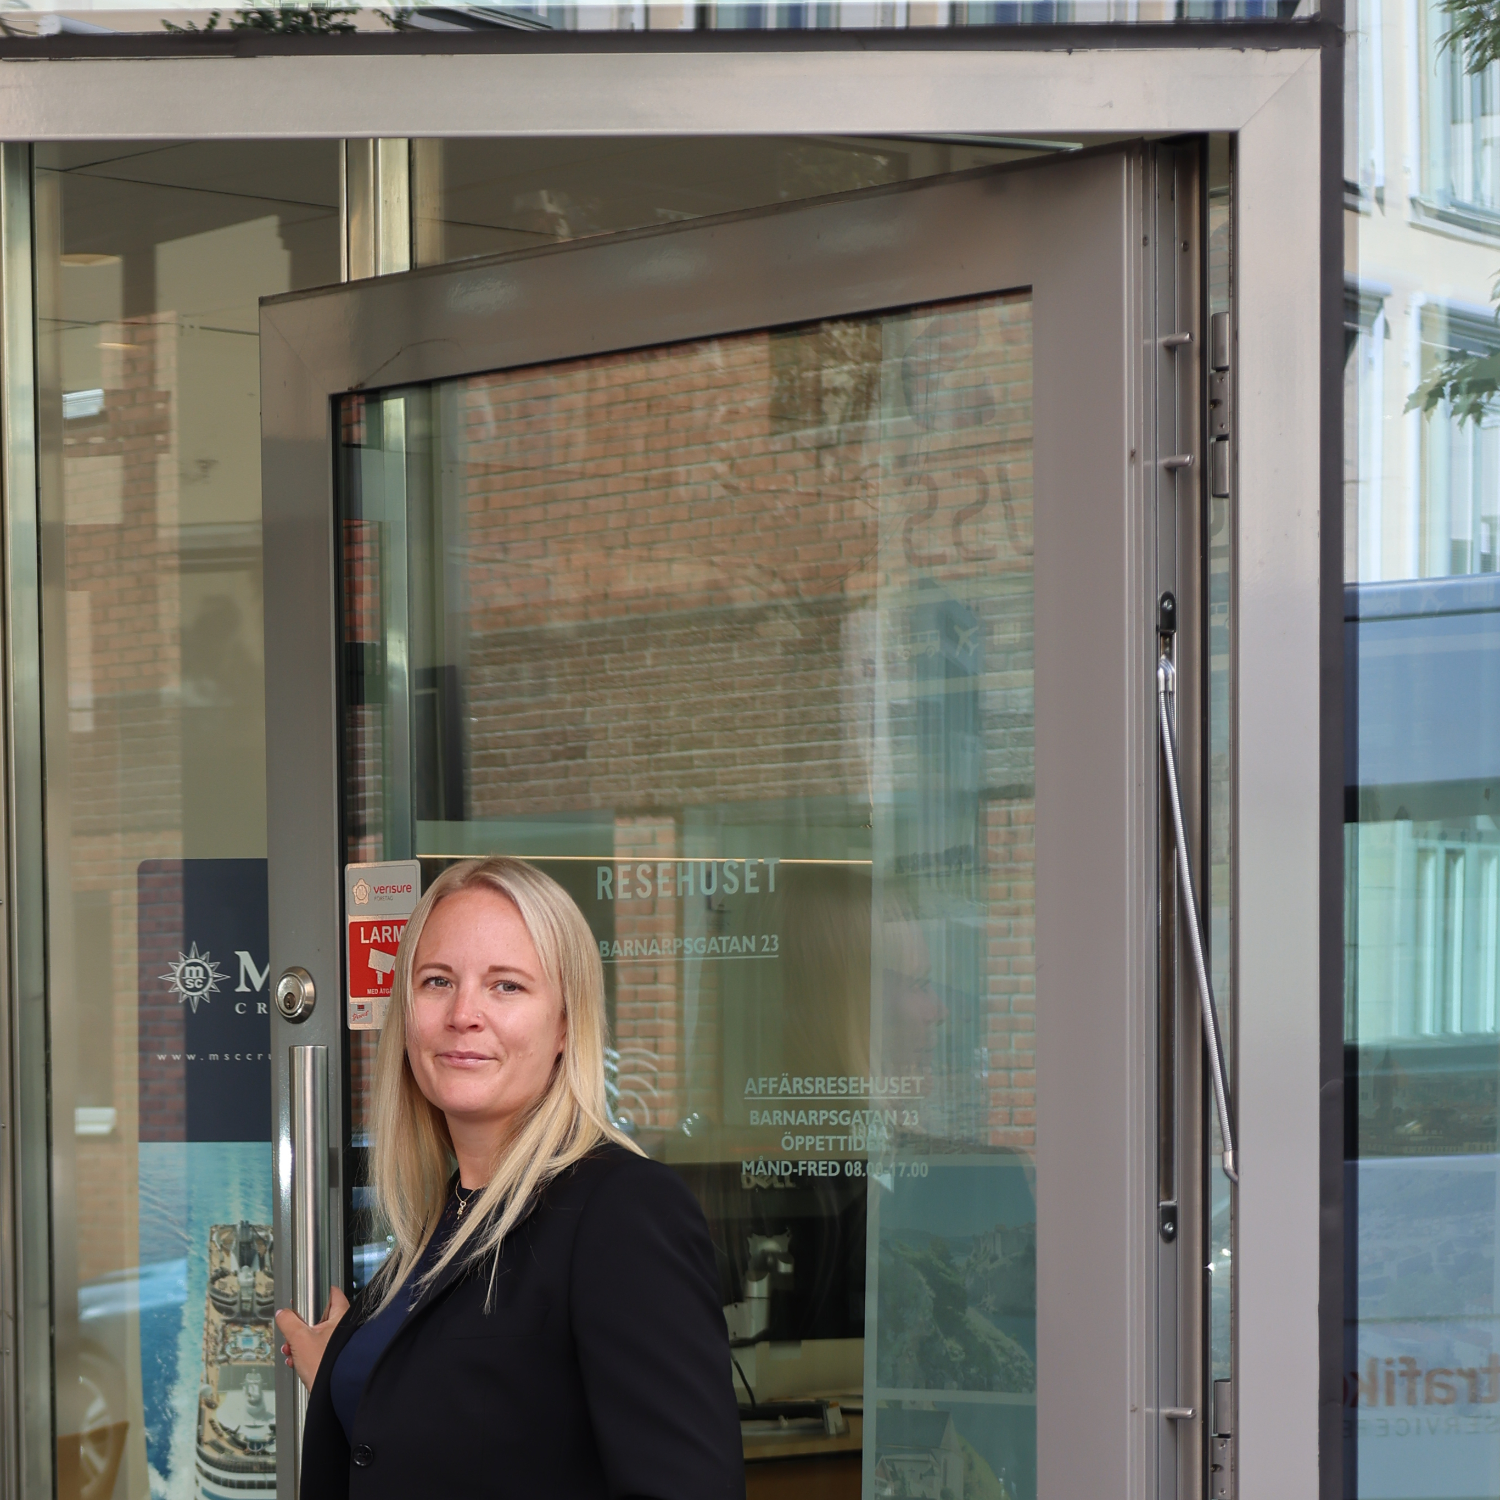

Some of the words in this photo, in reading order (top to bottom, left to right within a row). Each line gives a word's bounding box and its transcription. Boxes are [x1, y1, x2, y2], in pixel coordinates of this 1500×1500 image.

[373, 884, 412, 894] verisure
[597, 857, 780, 900] RESEHUSET
[600, 936, 756, 957] BARNARPSGATAN
[761, 934, 780, 952] 23
[744, 1073, 925, 1095] AFFÄRSRESEHUSET
[750, 1110, 897, 1126] BARNARPSGATAN
[902, 1110, 919, 1126] 23
[742, 1156, 840, 1176] MÅND-FRED
